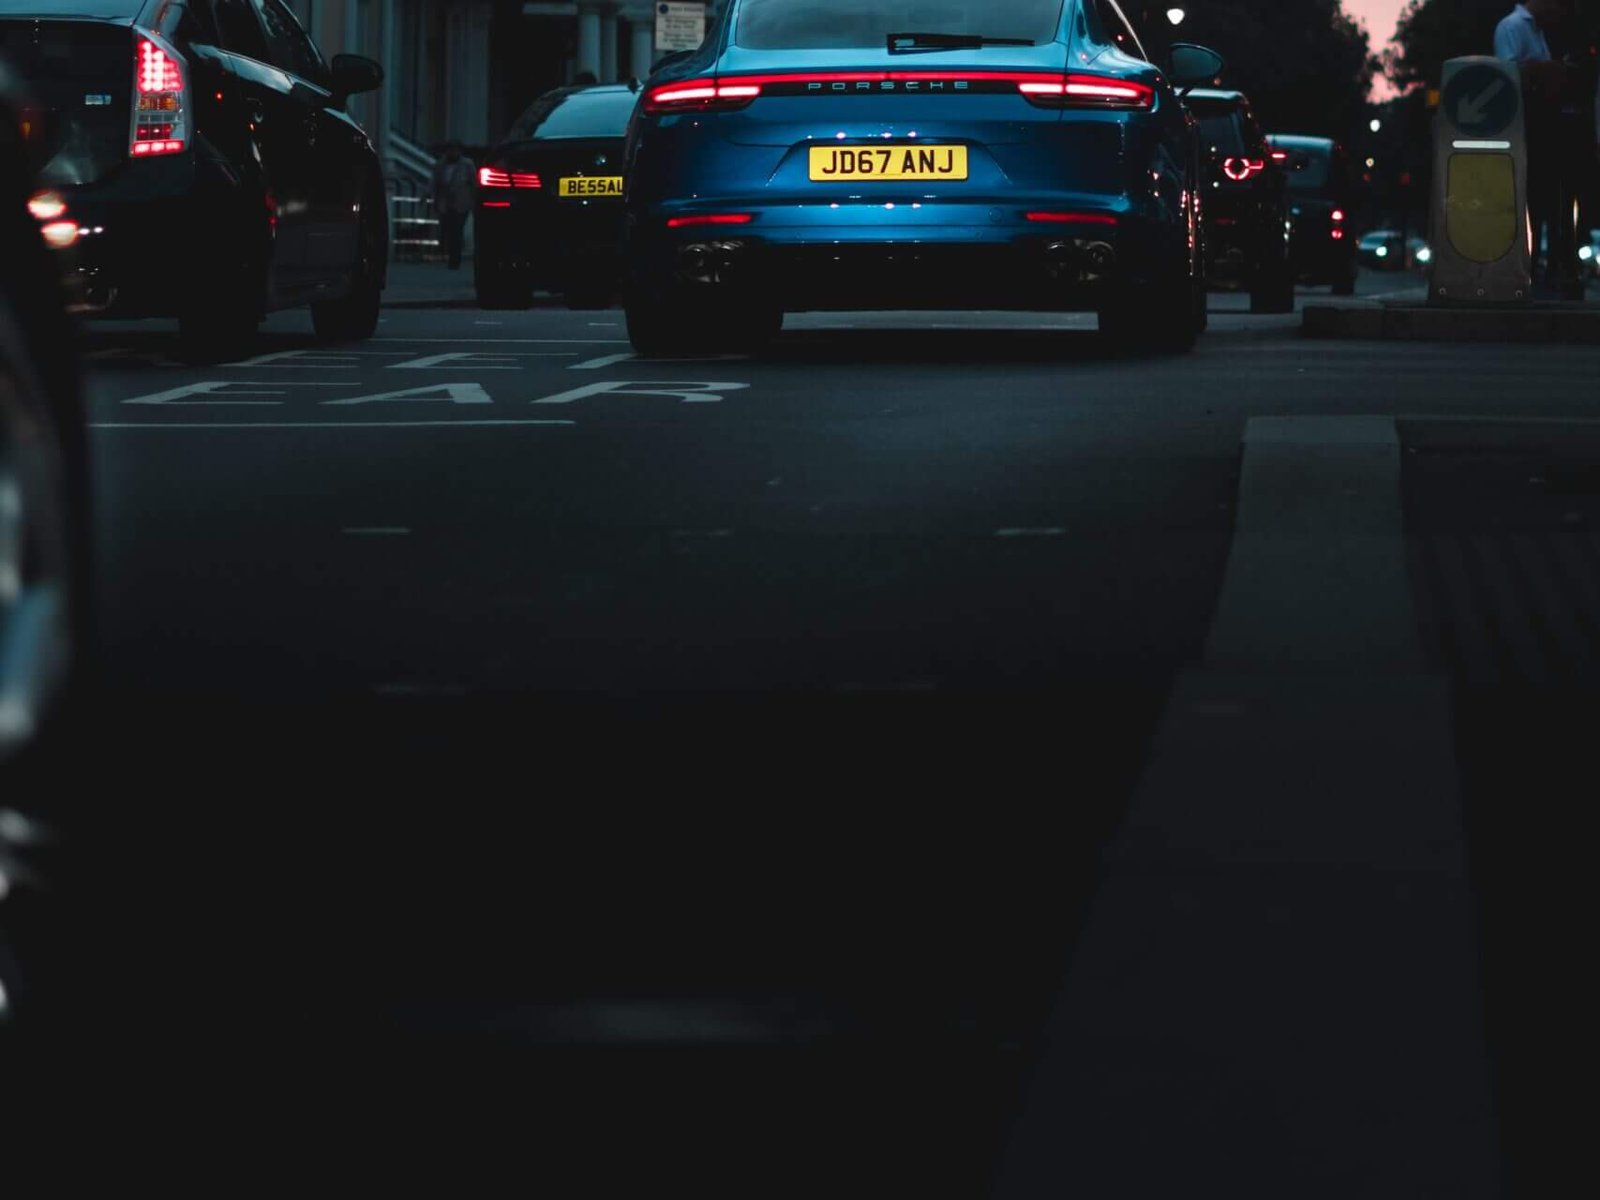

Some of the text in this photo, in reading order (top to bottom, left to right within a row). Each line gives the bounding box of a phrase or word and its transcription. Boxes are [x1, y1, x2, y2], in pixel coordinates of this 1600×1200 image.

[808, 81, 968, 90] PORSCHE
[822, 150, 953, 174] JD67 ANJ
